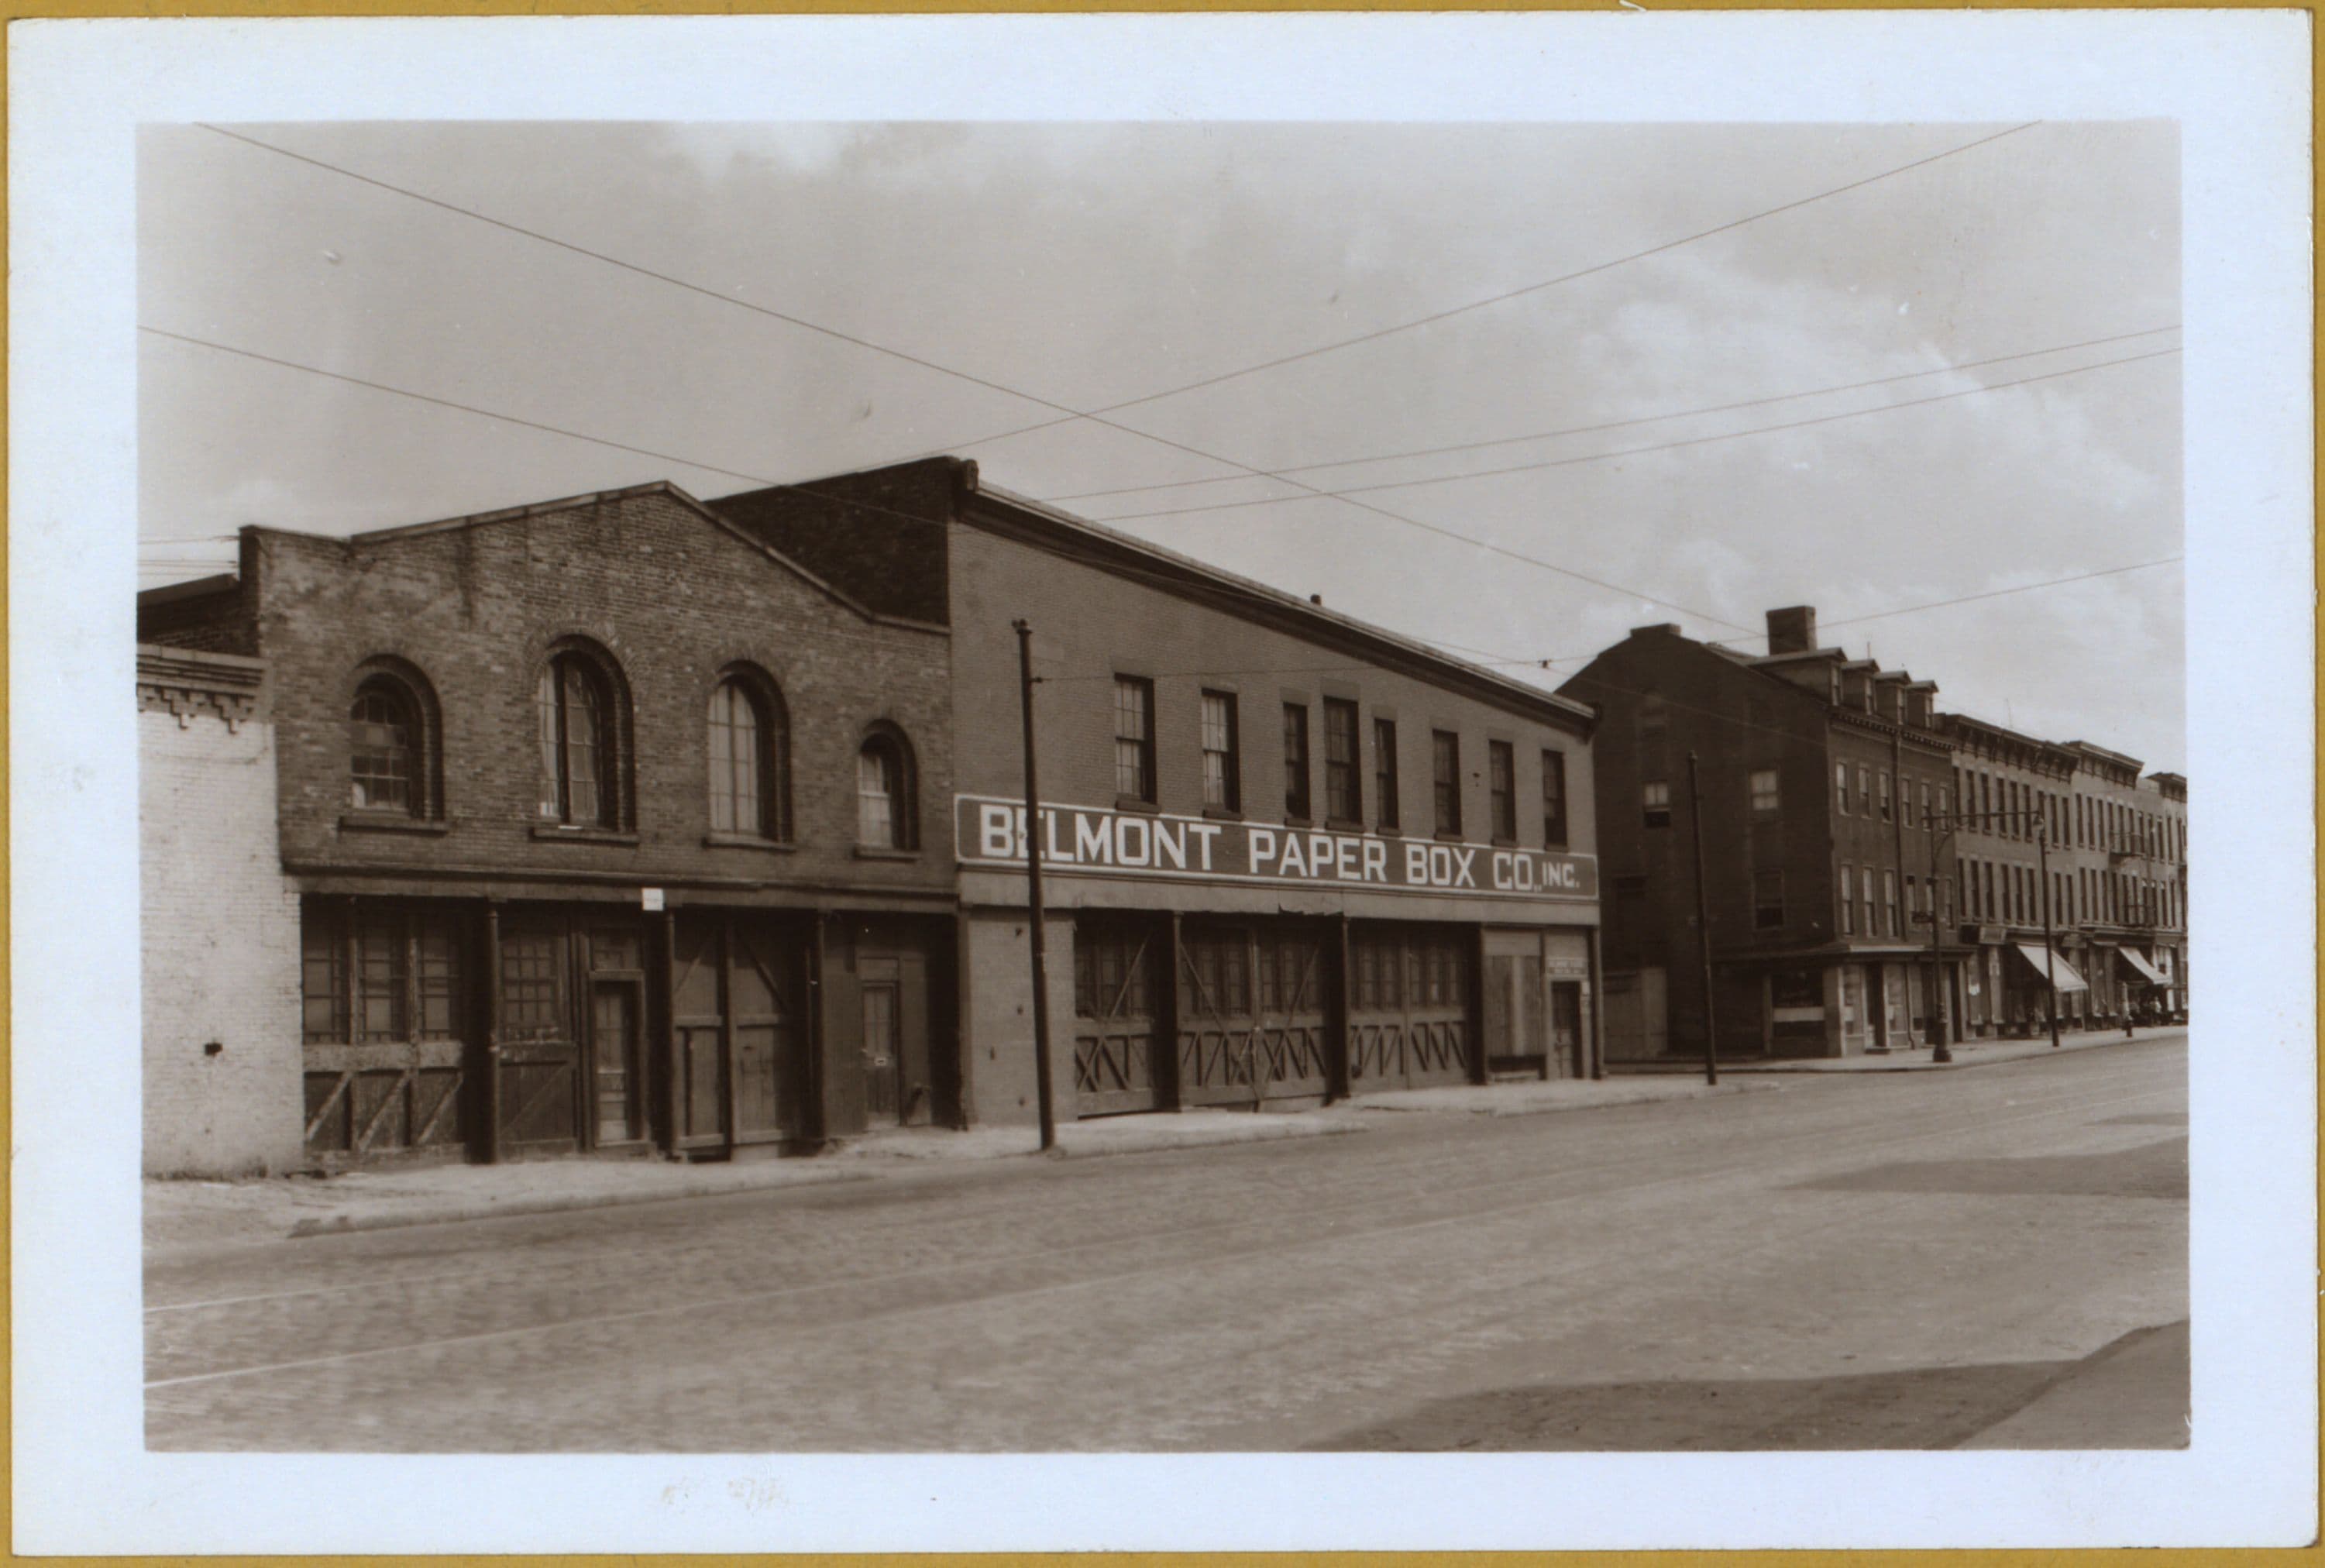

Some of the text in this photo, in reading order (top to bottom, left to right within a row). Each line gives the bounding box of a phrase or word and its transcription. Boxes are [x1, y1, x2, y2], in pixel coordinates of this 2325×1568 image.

[980, 804, 1222, 871] BELMONT
[1248, 829, 1387, 882] PAPER
[1405, 843, 1476, 888] BOX
[1542, 861, 1580, 889] INC.
